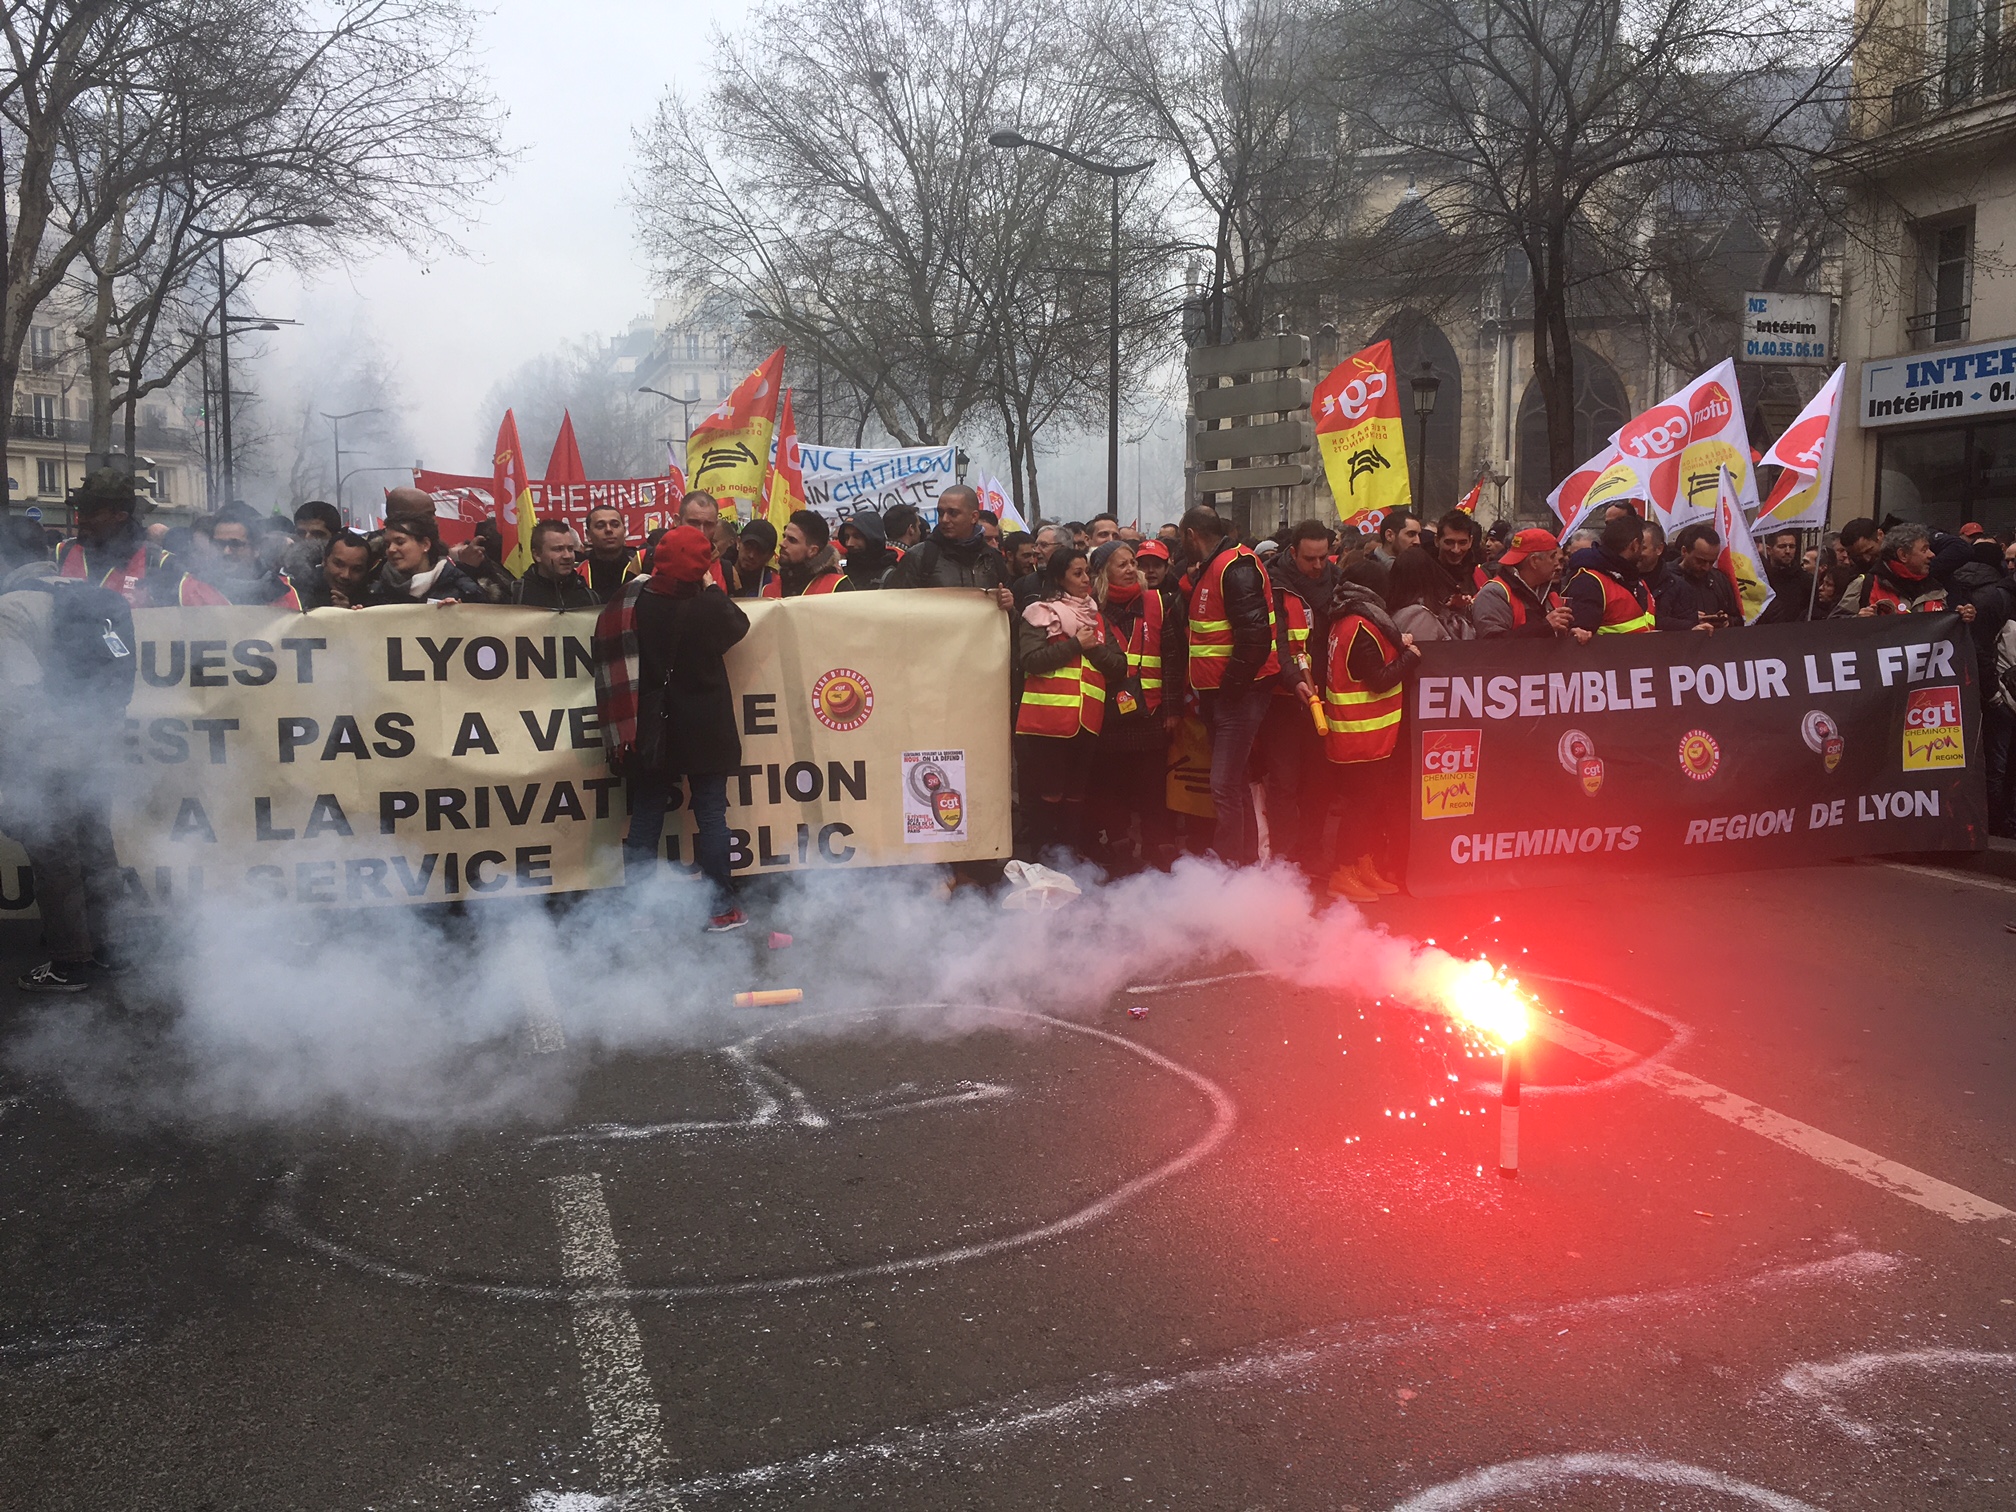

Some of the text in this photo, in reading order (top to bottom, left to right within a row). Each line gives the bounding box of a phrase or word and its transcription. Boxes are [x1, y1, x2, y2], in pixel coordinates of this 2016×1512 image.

[1756, 320, 1817, 335] Intérim
[1868, 381, 2016, 417] Intérim 01.
[813, 676, 829, 696] PLAN
[830, 669, 872, 696] D'URGENCE
[1417, 639, 1957, 720] ENSEMBLE POUR LE FER
[816, 708, 871, 730] FERROVIAIRE
[1906, 700, 1957, 730] cgt
[278, 712, 417, 763] PAS
[451, 712, 499, 757] A
[1904, 727, 1960, 737] CHEMINOTS
[1424, 745, 1475, 774] cgt
[1907, 735, 1959, 763] Lyon
[1423, 772, 1475, 783] CHEMINOTS
[1583, 764, 1601, 777] cgt
[940, 797, 960, 809] cgt
[1426, 781, 1471, 811] Lyon
[1449, 801, 1474, 809] REGION
[170, 797, 218, 843] A
[254, 790, 354, 842] LA
[1449, 789, 1940, 865] CHEMINOTS REGION DE LYON
[244, 845, 553, 902] SERVICE
